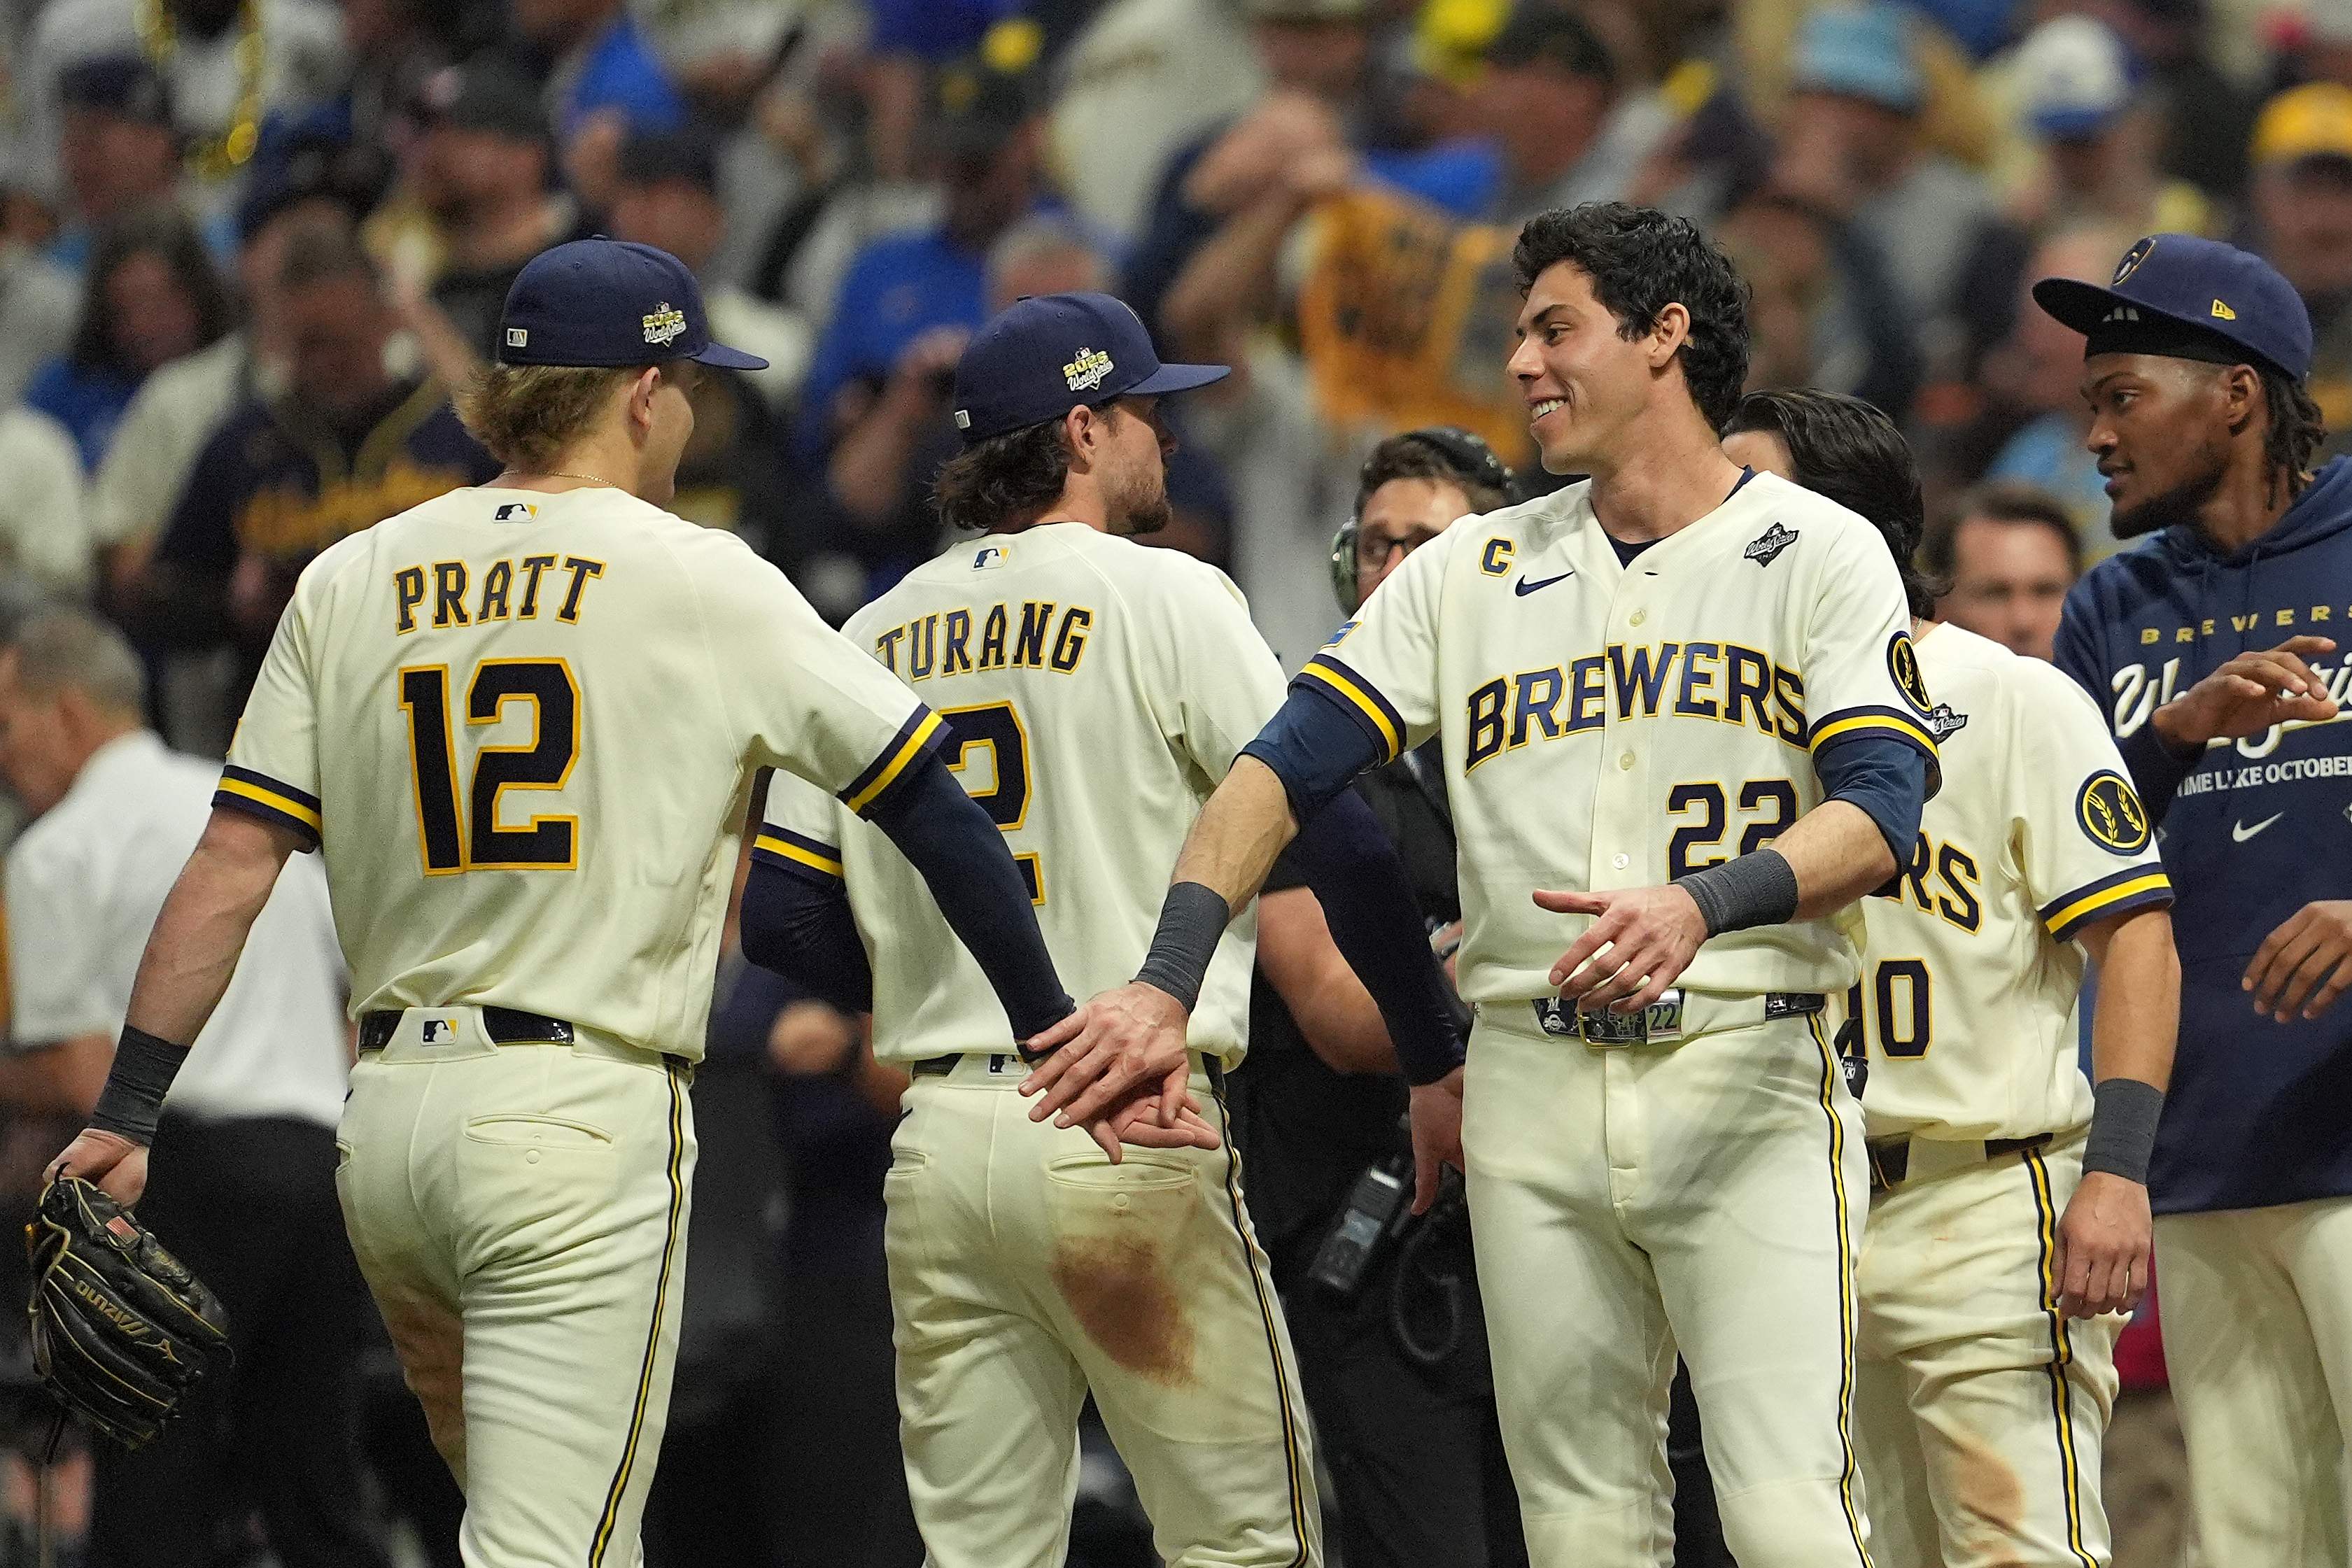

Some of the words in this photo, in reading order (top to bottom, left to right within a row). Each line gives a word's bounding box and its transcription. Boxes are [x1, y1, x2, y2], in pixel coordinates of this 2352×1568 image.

[393, 553, 607, 636] PRATT
[1479, 536, 1516, 577] C
[875, 599, 1094, 682] TURANG
[1464, 640, 1810, 777] BREWERS
[397, 656, 582, 877] 12
[939, 699, 1045, 906] 2
[1666, 777, 1800, 883] 22
[1649, 1003, 1677, 1031] 22
